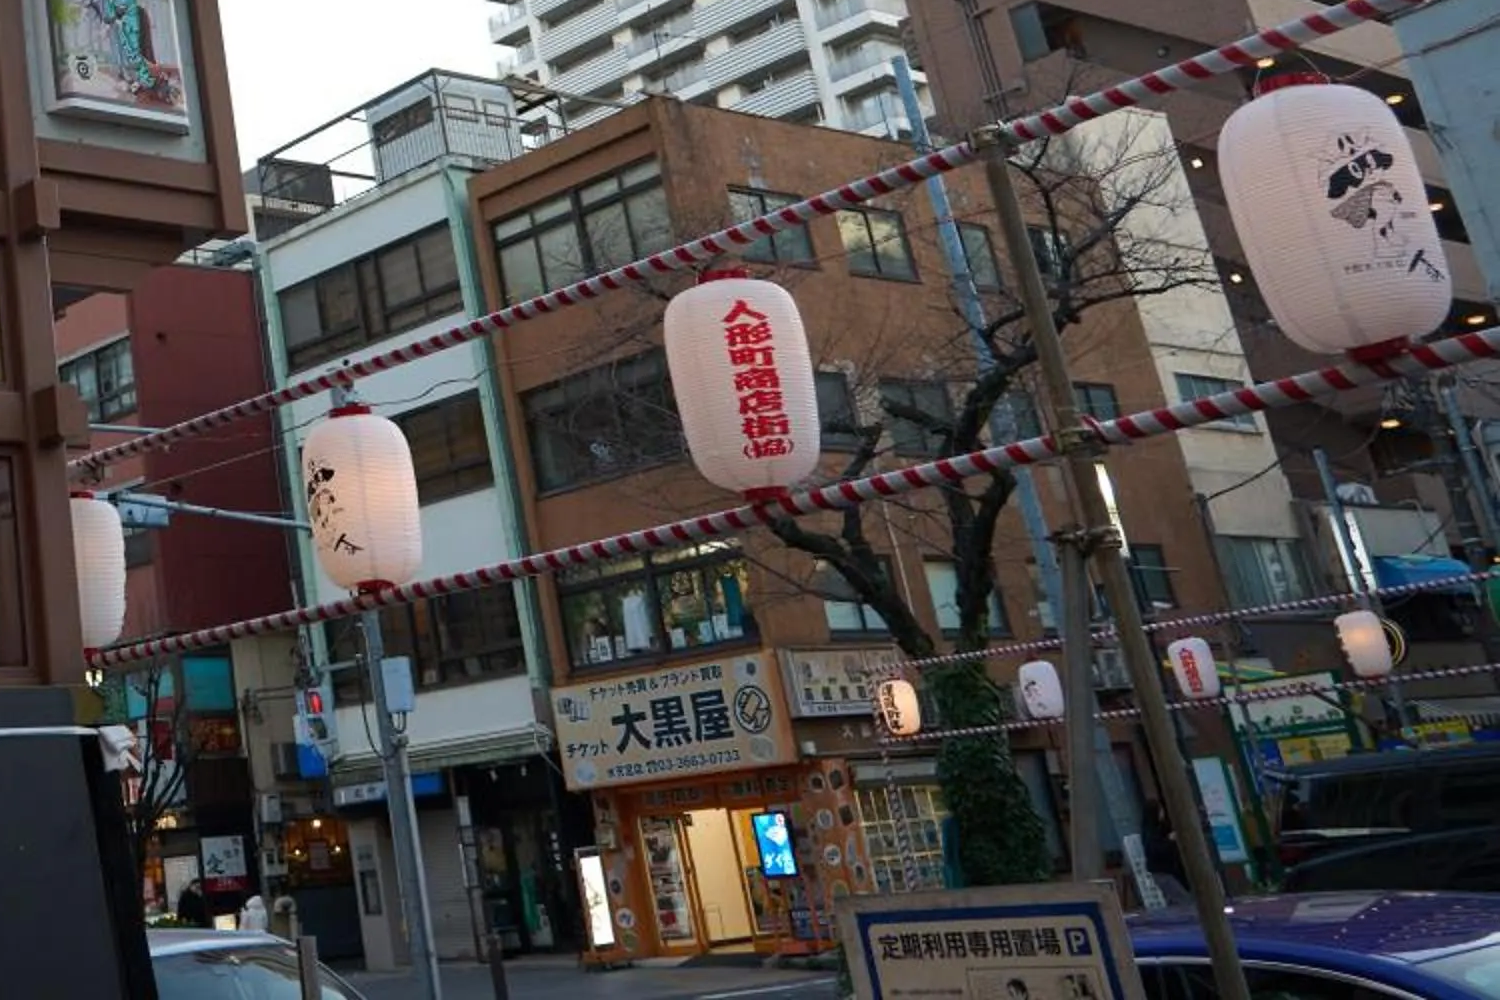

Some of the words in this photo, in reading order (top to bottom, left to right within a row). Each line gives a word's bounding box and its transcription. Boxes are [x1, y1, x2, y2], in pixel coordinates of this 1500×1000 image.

[612, 689, 735, 754] 大黒屋
[566, 741, 609, 757] チケット
[877, 927, 1062, 961] 定期利用専用置場
